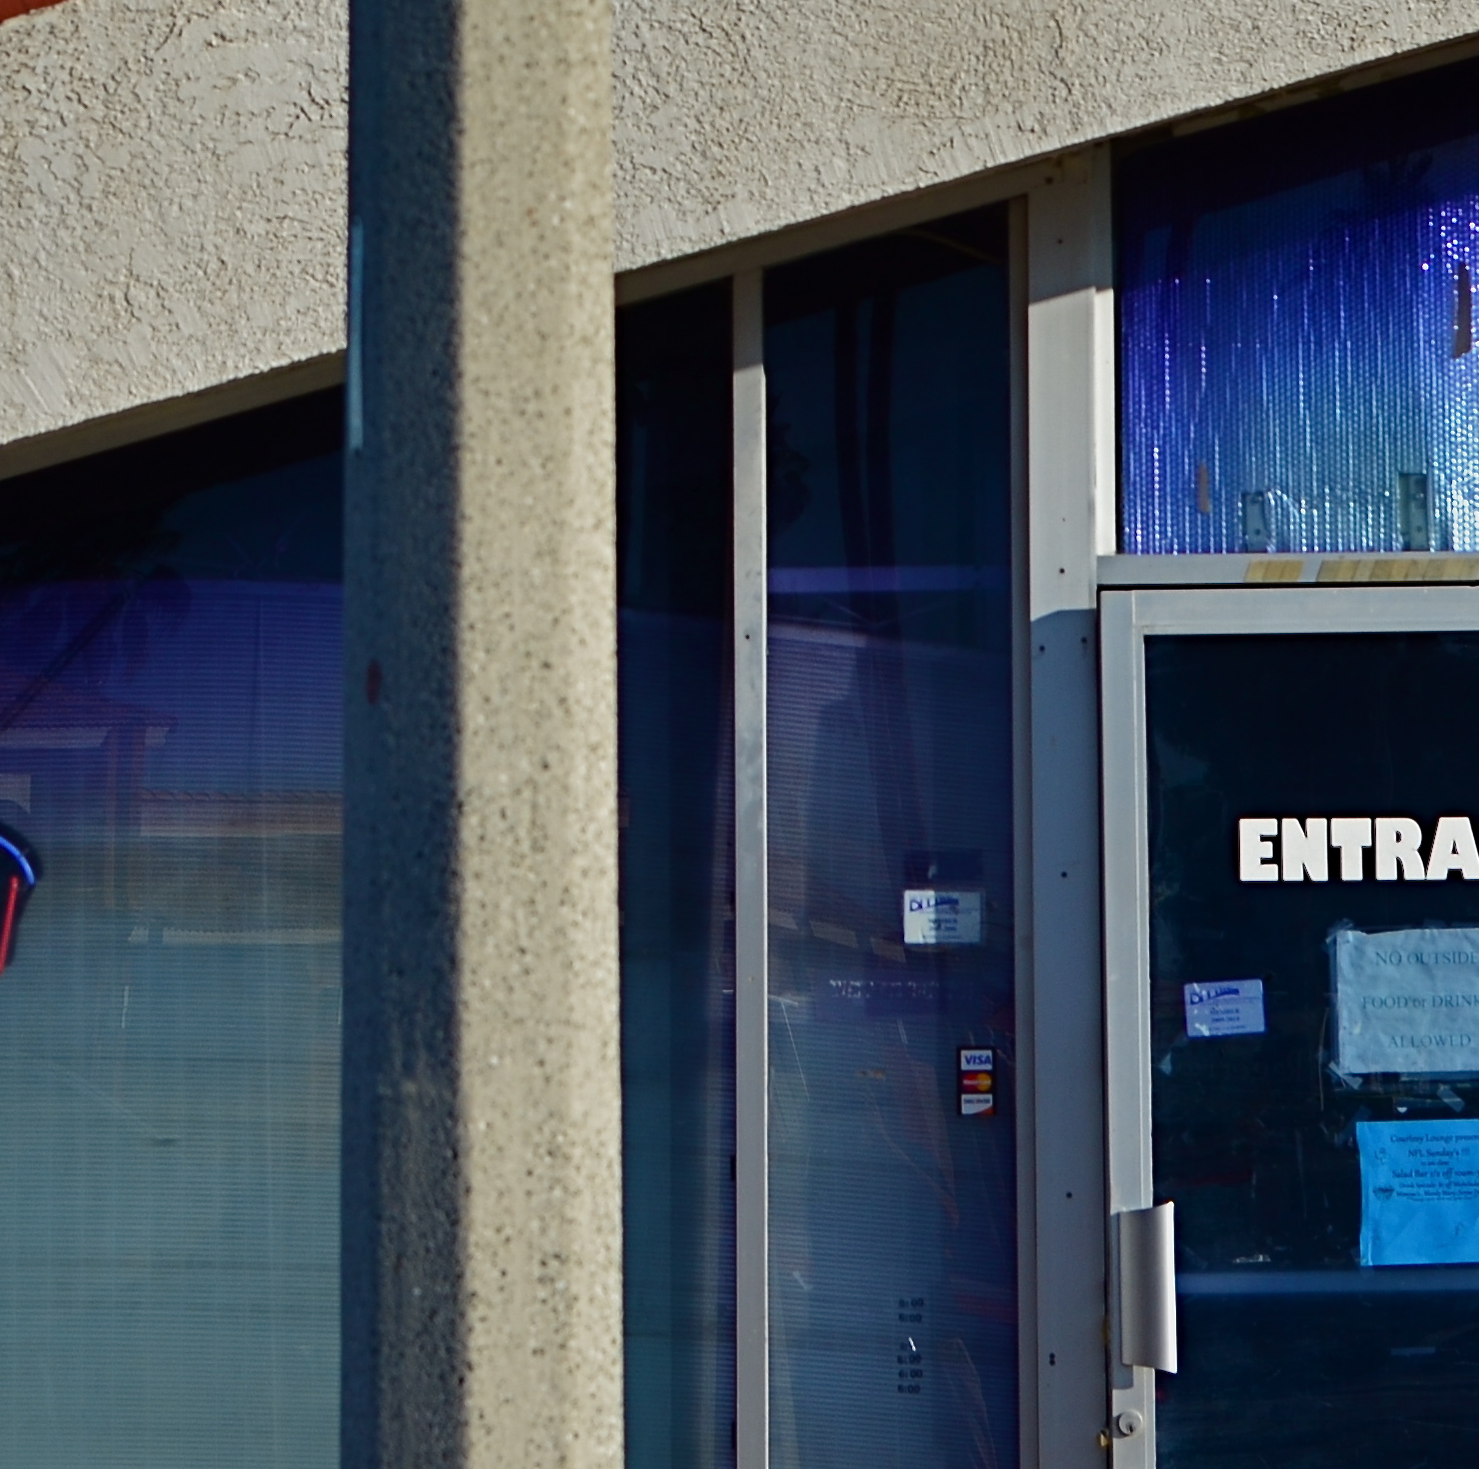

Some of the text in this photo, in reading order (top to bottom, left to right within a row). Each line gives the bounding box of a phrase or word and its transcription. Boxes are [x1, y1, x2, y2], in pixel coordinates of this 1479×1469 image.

[1375, 950, 1479, 966] NO OUTSIDE
[1362, 995, 1408, 1010] FOOD
[1413, 998, 1426, 1009] or
[1388, 1034, 1472, 1049] ALLOWED
[964, 1054, 992, 1066] VISA
